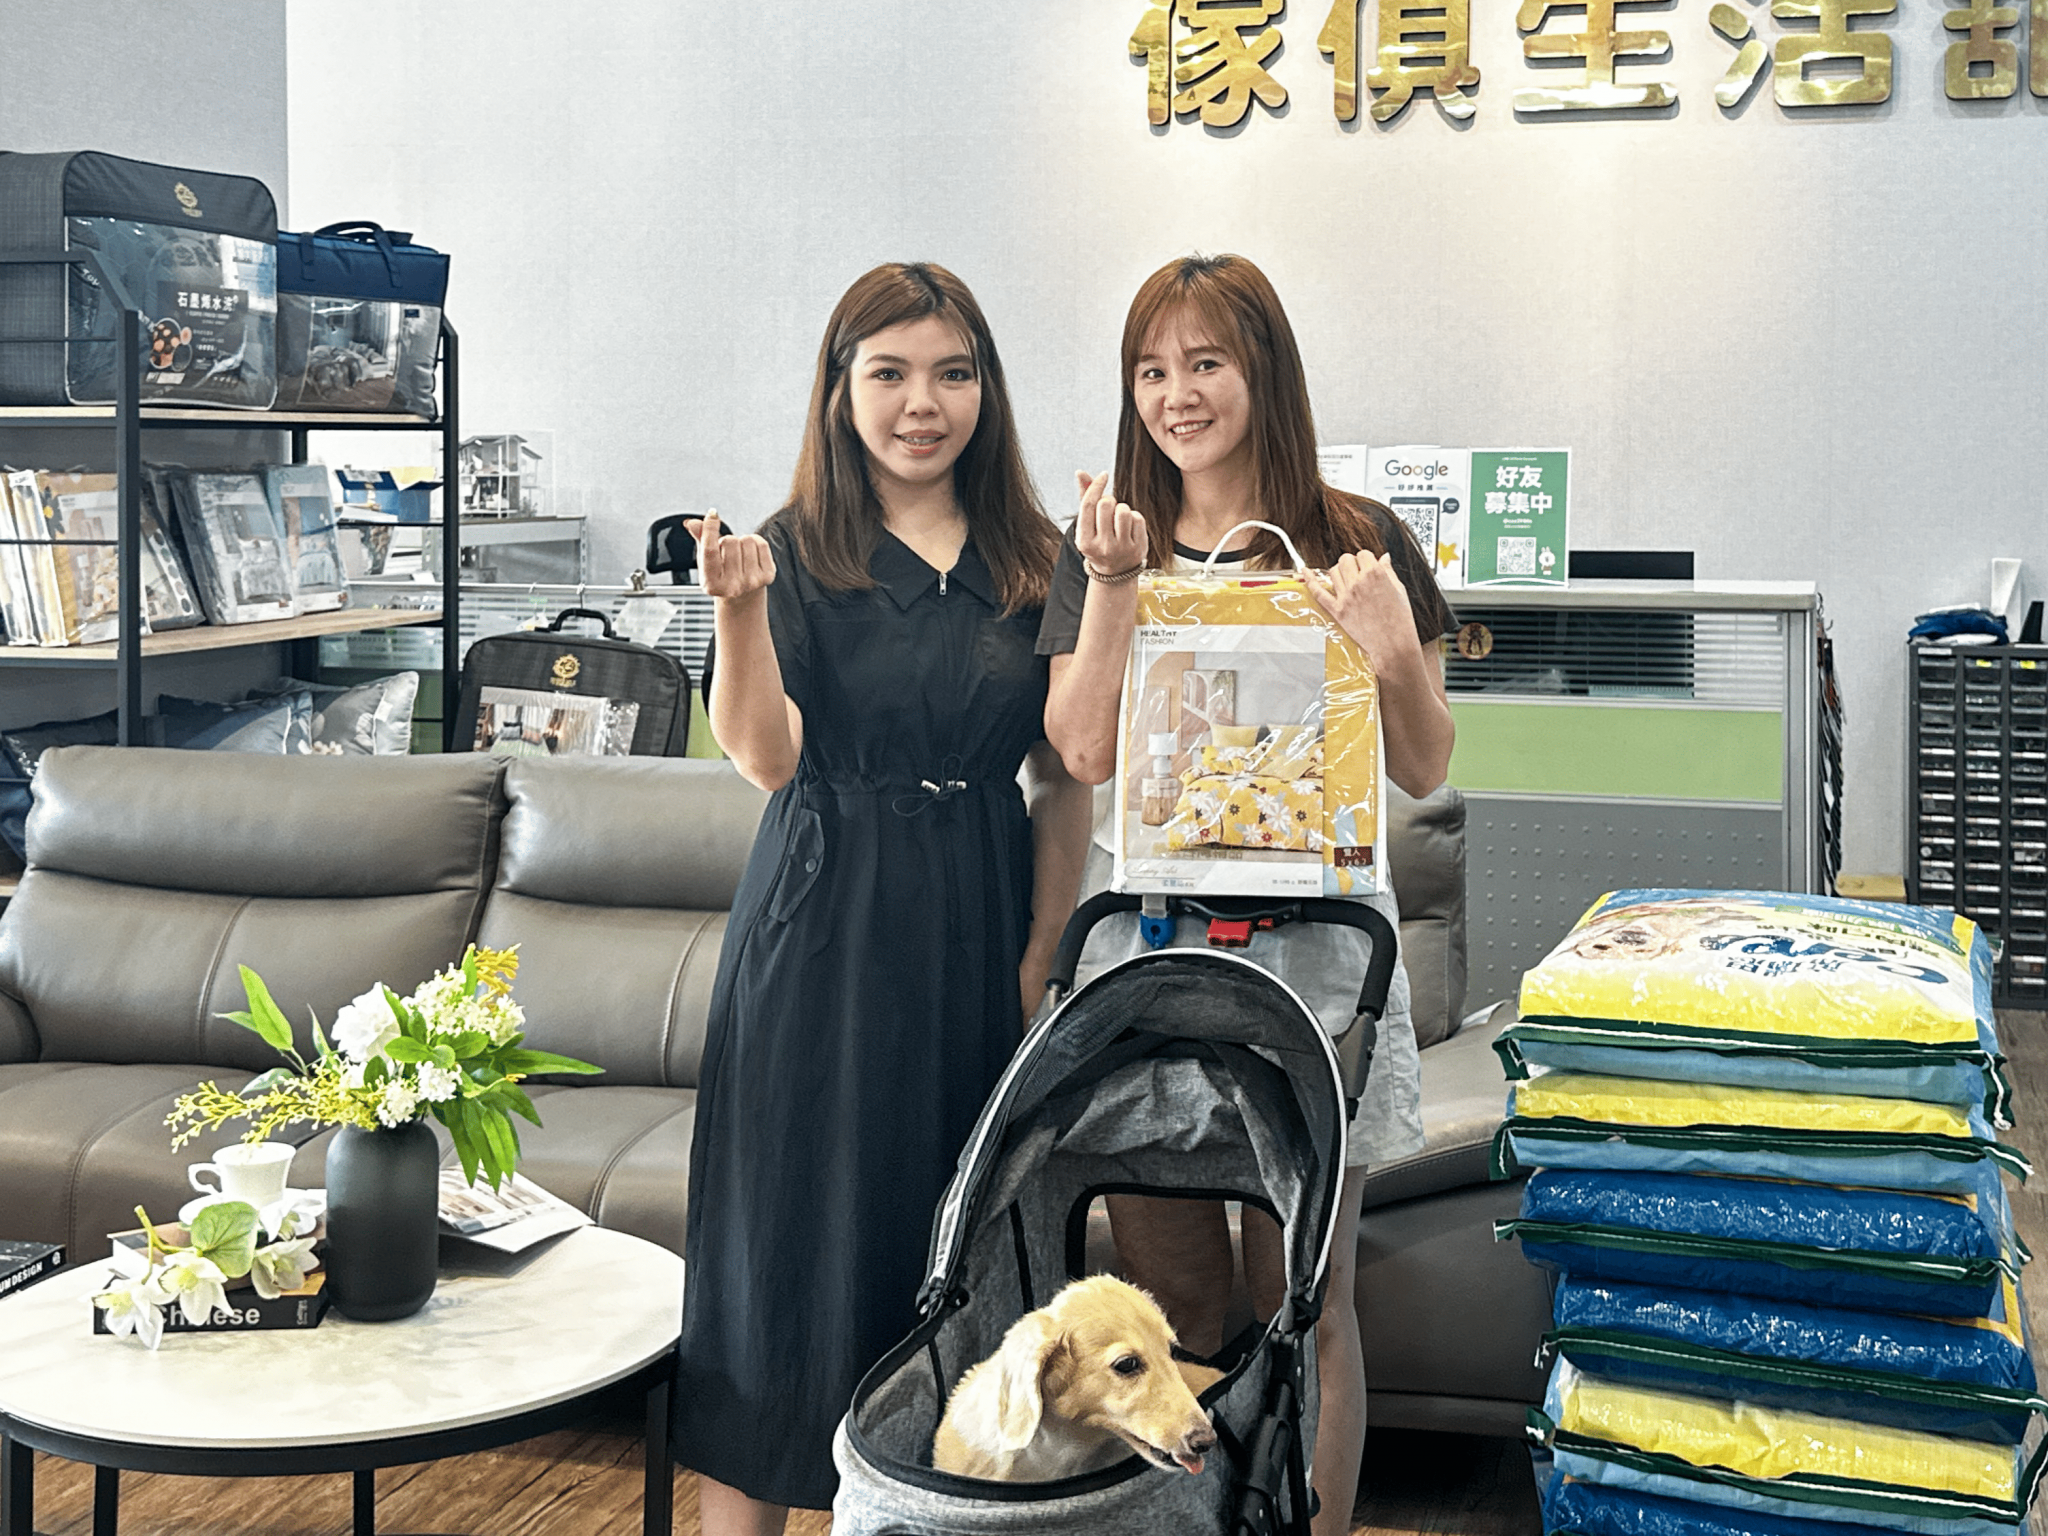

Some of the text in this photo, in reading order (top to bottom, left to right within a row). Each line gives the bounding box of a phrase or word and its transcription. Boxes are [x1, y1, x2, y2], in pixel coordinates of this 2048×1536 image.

[1385, 459, 1448, 481] Google
[1496, 465, 1543, 489] 好友
[1484, 491, 1553, 515] 募集中
[12, 1261, 43, 1286] DESIGN
